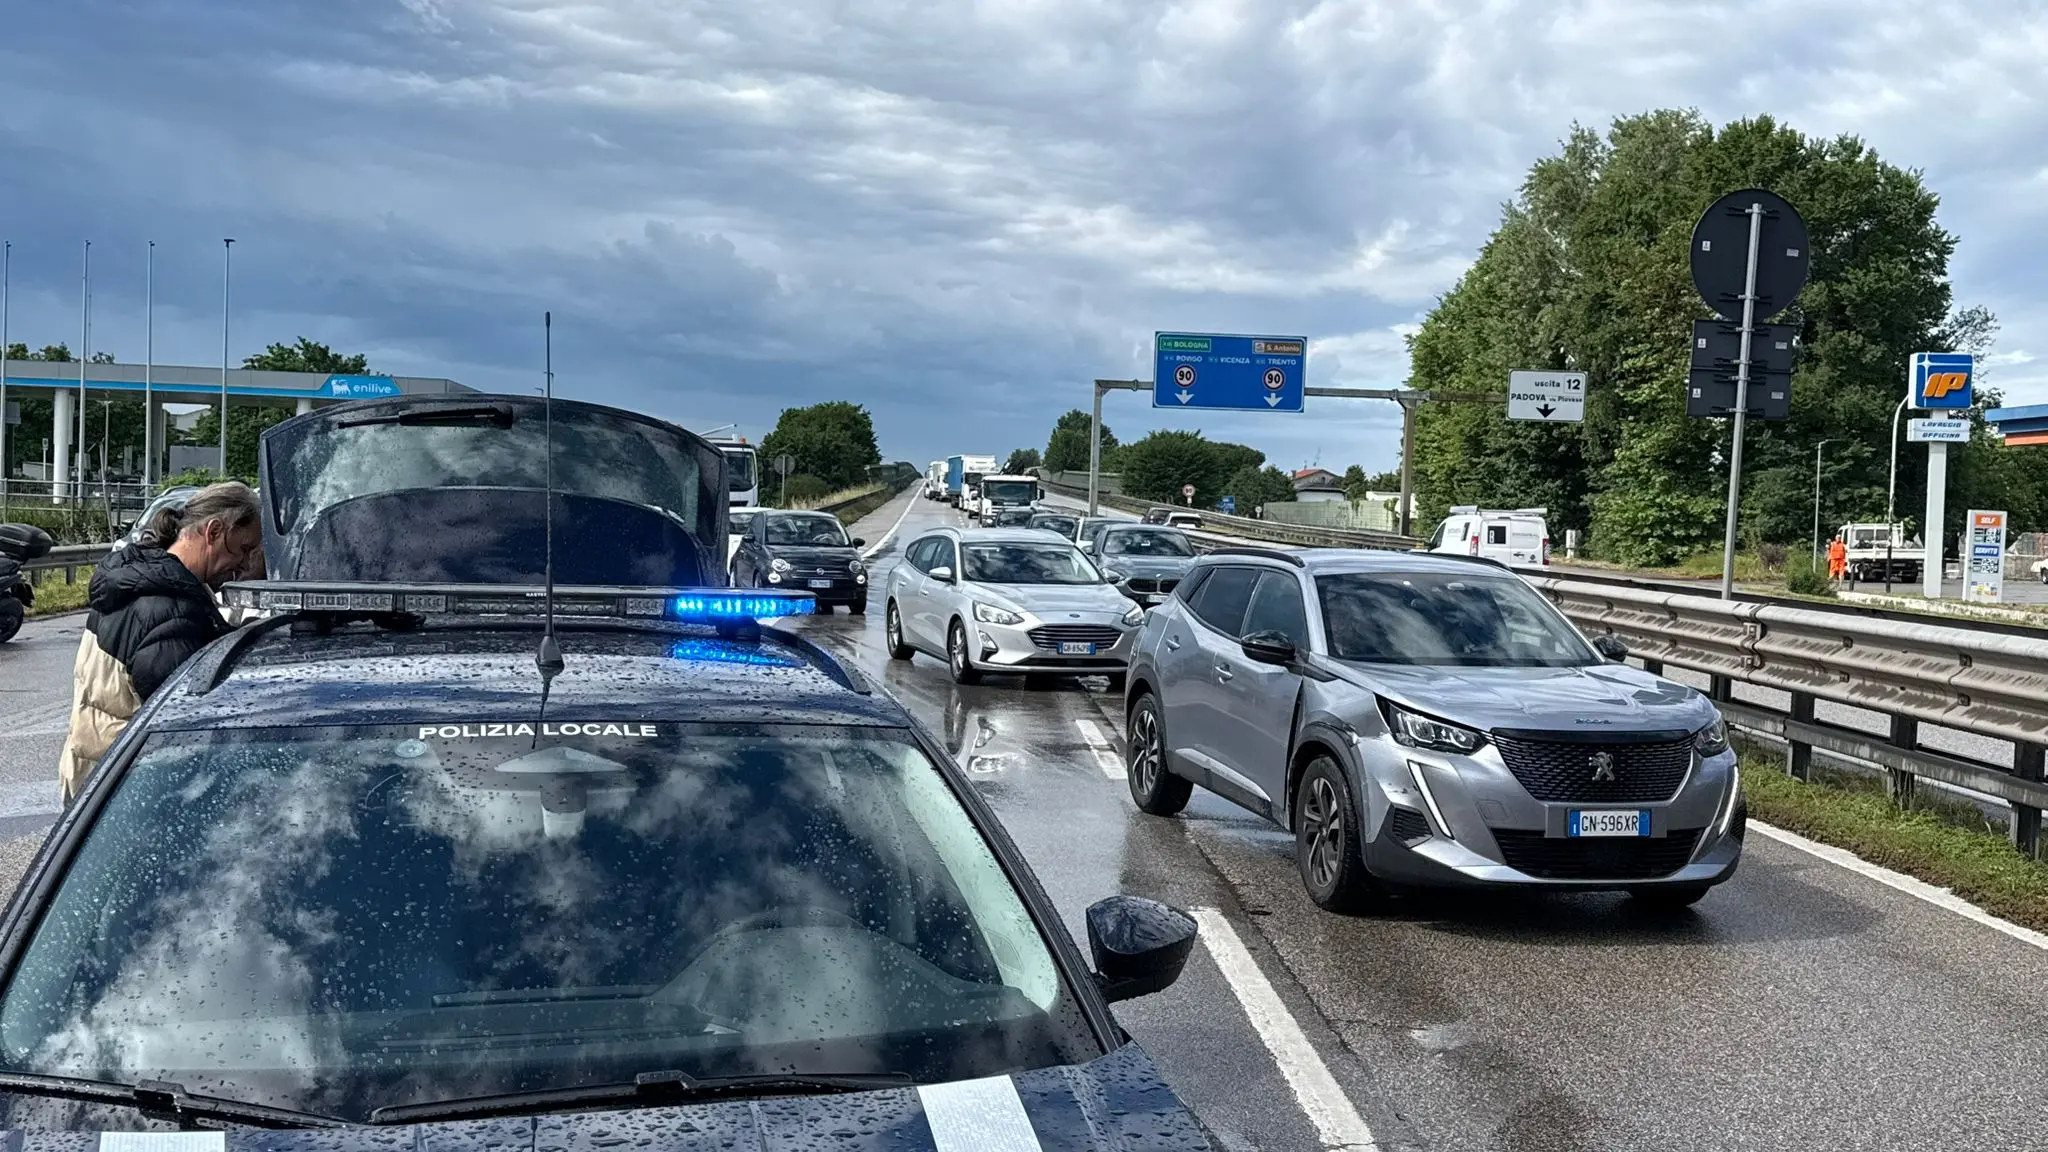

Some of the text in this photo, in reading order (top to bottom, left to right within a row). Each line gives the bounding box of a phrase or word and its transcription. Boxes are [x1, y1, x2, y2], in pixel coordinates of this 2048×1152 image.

[1174, 341, 1209, 349] BOLOGNA
[1220, 356, 1250, 364] VICENZA
[1268, 358, 1297, 366] TRENTO
[1178, 370, 1192, 381] 90
[1267, 373, 1281, 384] 90
[353, 383, 392, 394] enilive
[1534, 378, 1581, 390] uscita 12
[1922, 372, 1968, 398] IP
[1511, 393, 1546, 401] PADOVA
[1980, 516, 1996, 525] SELF
[418, 723, 659, 740] POLIZIA LOCALE
